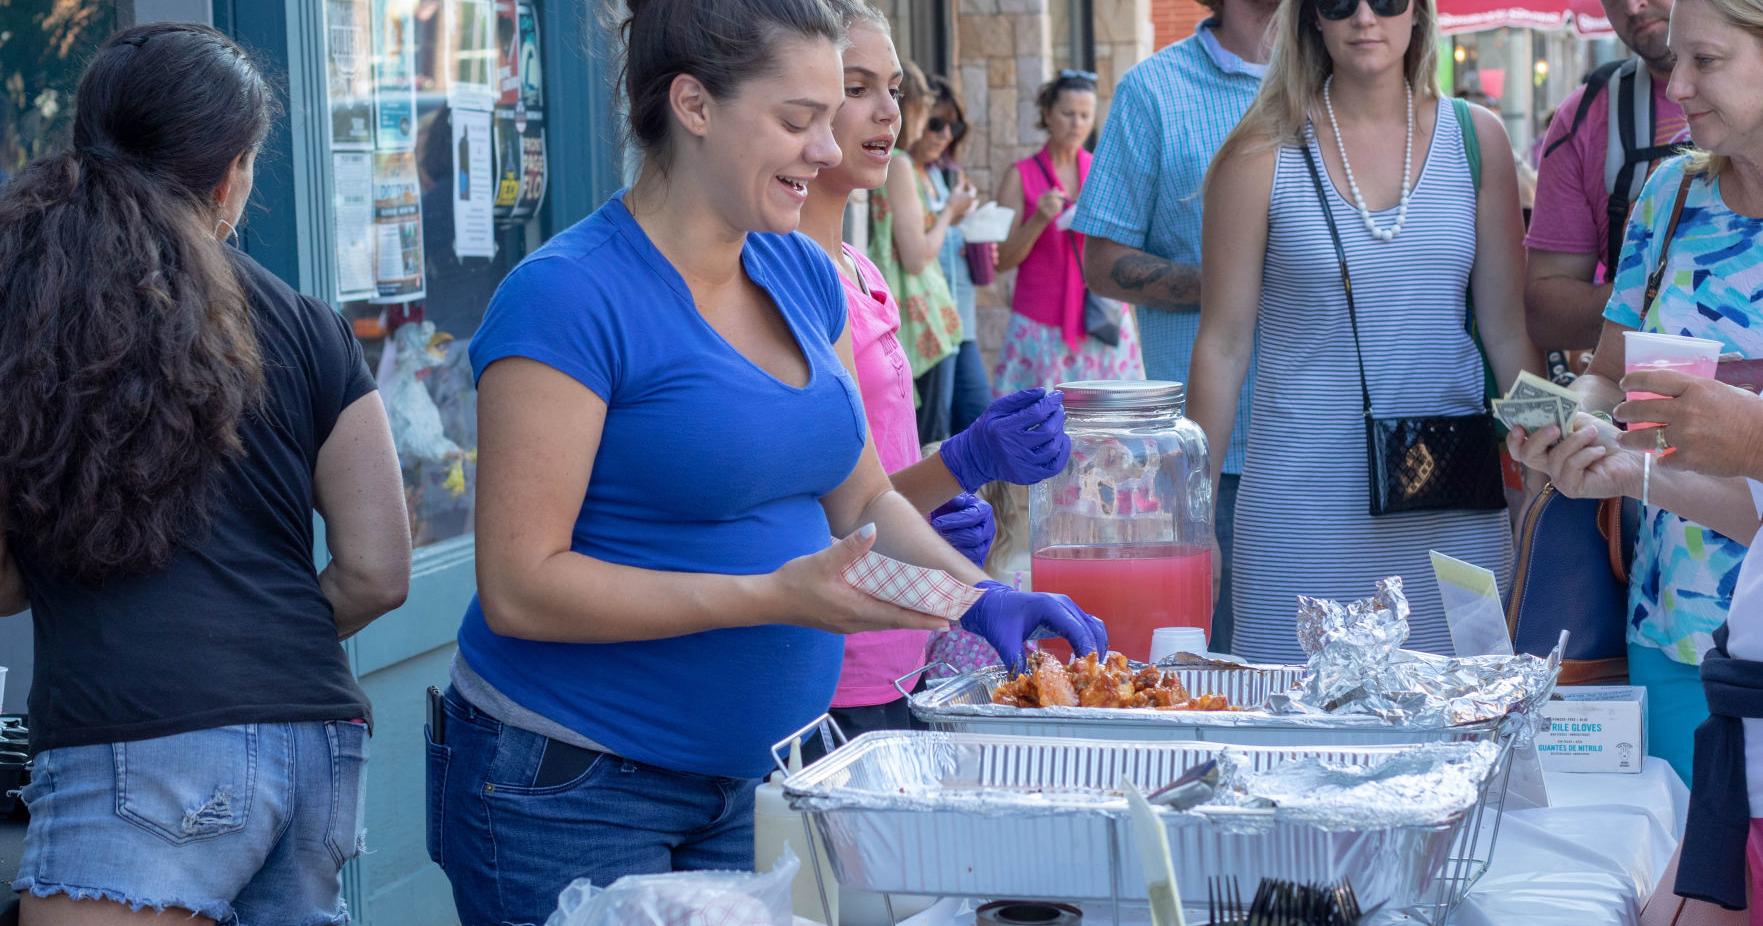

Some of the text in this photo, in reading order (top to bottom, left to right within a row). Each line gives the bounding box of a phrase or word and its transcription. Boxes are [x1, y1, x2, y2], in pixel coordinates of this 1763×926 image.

[1552, 723, 1602, 732] RILE GLOVES
[1538, 744, 1603, 752] GUANTES DE NITRILO
